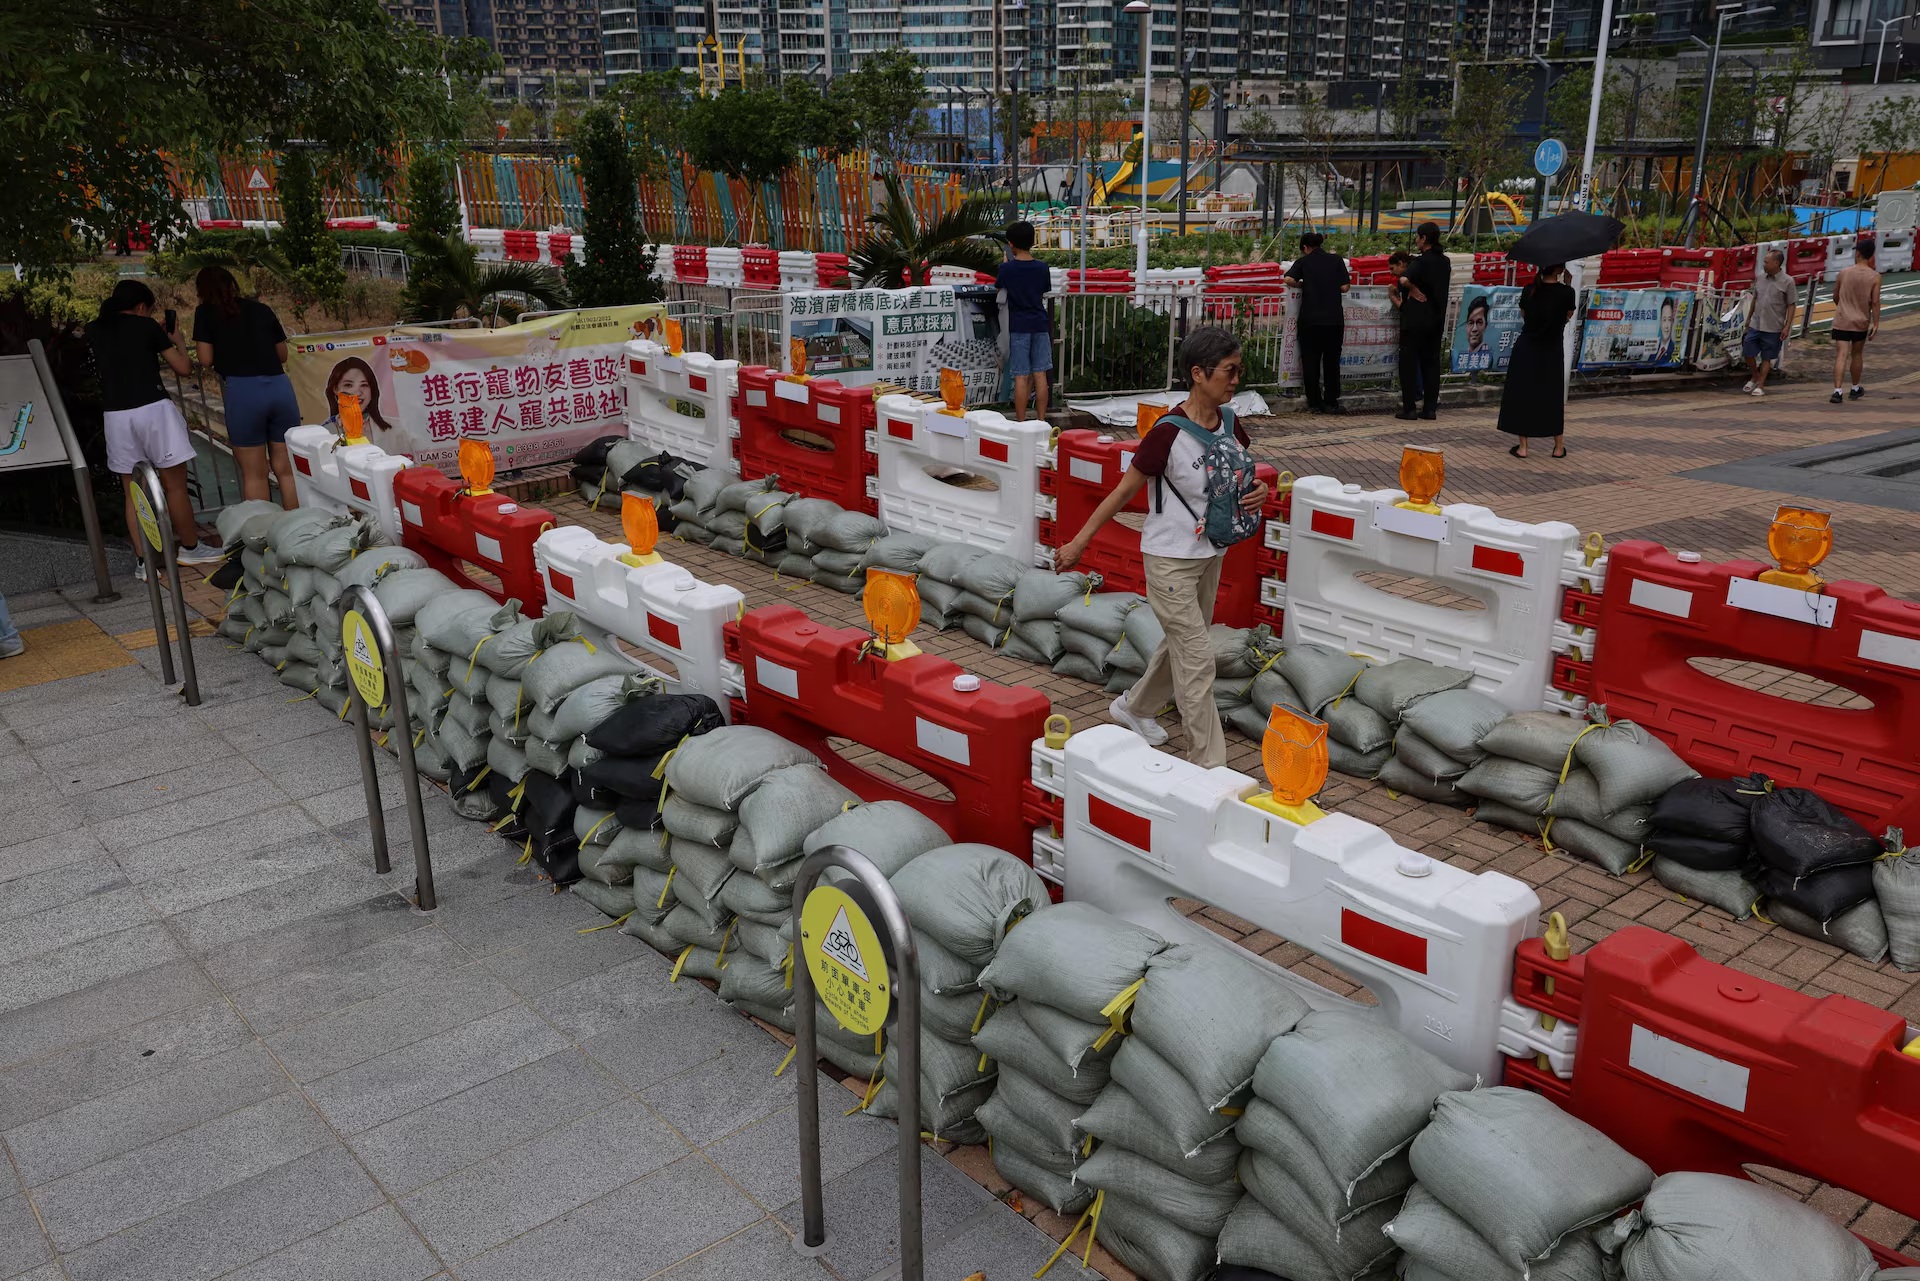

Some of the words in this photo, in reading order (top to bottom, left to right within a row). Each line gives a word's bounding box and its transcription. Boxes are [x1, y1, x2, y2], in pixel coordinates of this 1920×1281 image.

[790, 290, 954, 315] 海濱南橋橋底改善工程
[887, 313, 954, 333] 意見被採納
[1458, 353, 1490, 370] 張美雄
[422, 354, 625, 404] 推行寵物友善政
[877, 372, 995, 390] 美雄議力爭取
[428, 388, 627, 441] 構建人寵共融社
[420, 452, 439, 462] LAM
[442, 451, 453, 459] So
[516, 442, 539, 453] 6398
[543, 438, 565, 449] 2561
[821, 960, 871, 1004] 前面單車徑
[827, 977, 866, 1013] 小心單車
[825, 987, 838, 1001] Cycle
[840, 998, 851, 1011] track
[854, 1009, 869, 1023] ahead
[825, 994, 842, 1011] Beware
[850, 1013, 870, 1031] bicycles
